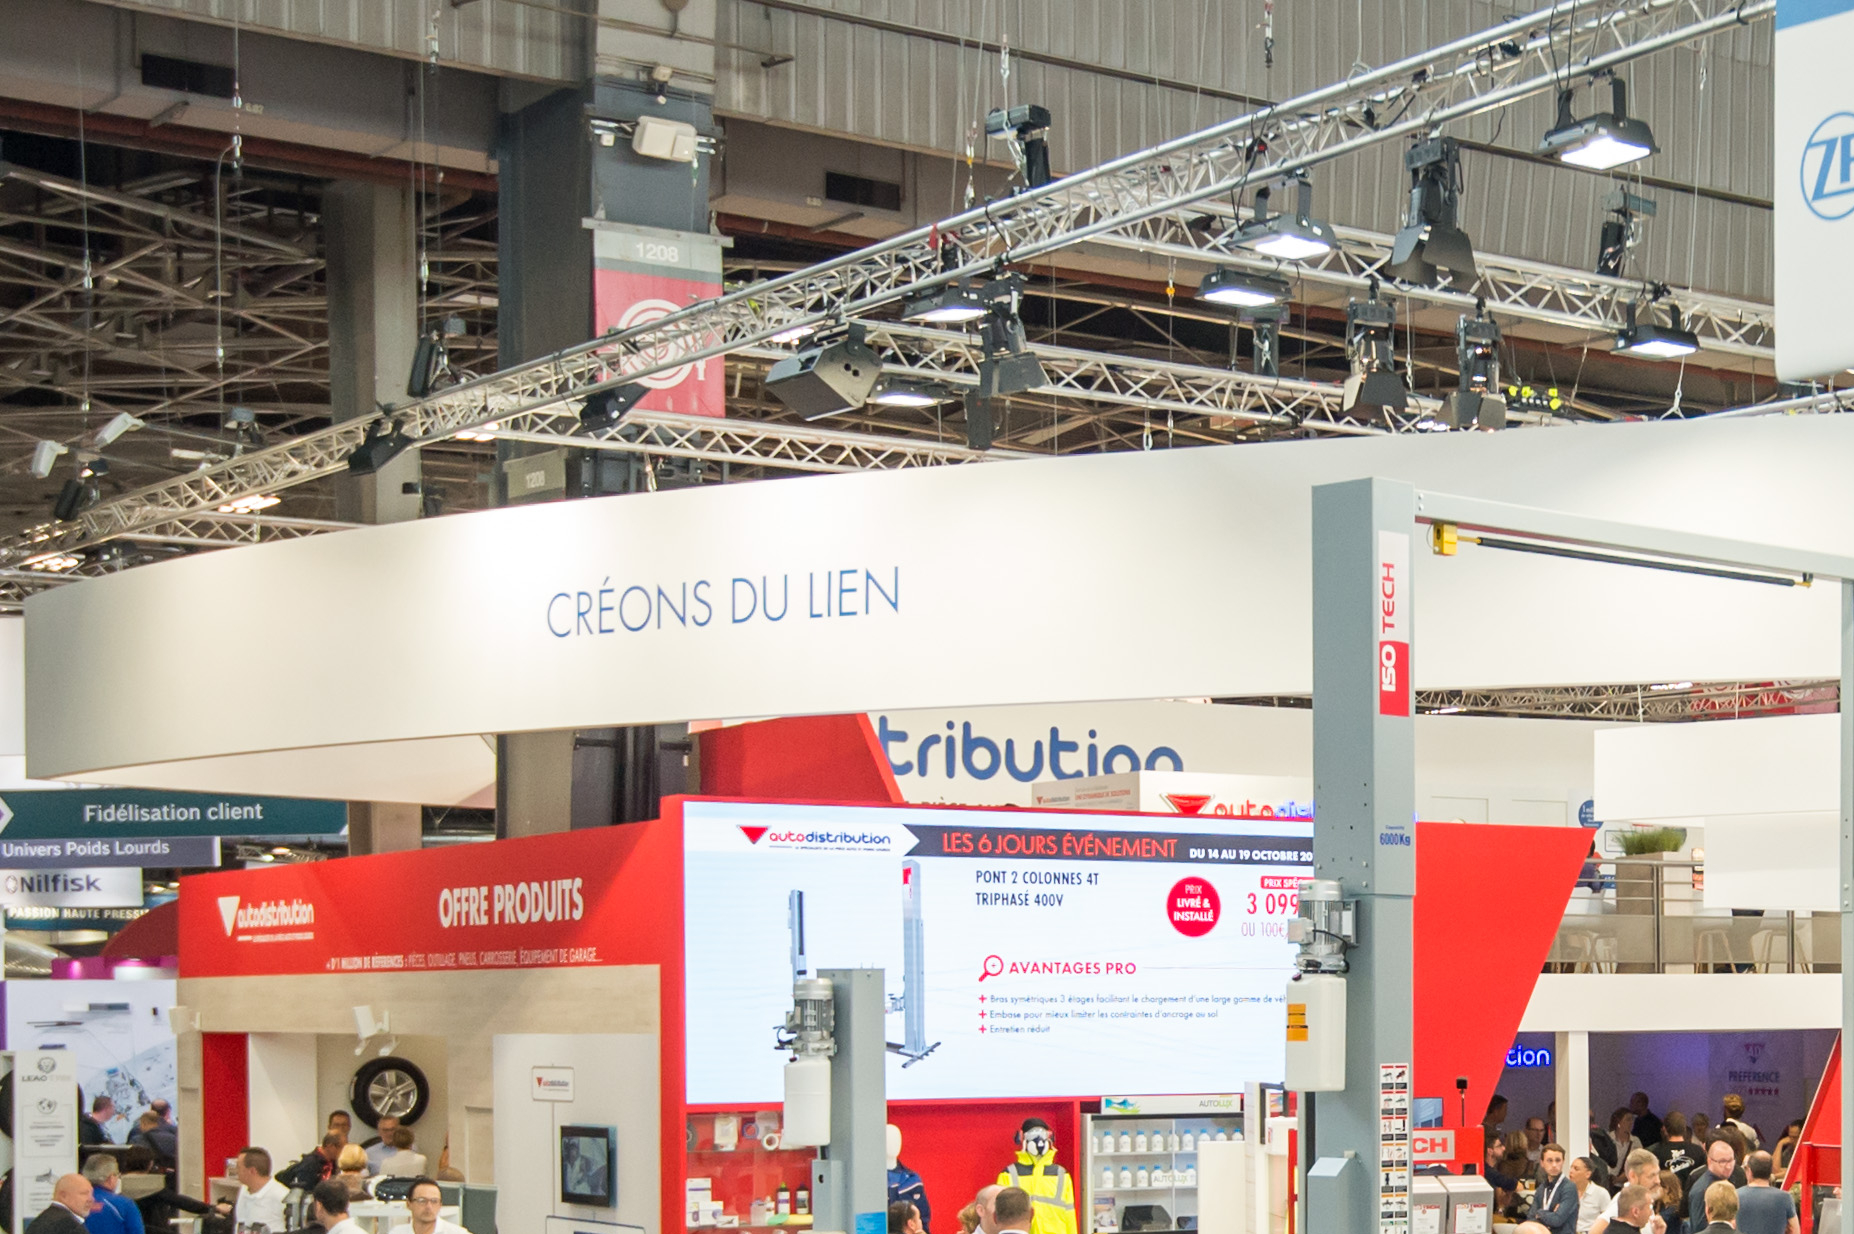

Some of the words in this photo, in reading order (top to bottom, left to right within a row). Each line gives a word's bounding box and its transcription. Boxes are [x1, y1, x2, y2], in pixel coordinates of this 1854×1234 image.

[635, 240, 680, 264] 1208
[547, 575, 713, 638] CRÉONS
[731, 573, 788, 624] DU
[809, 565, 900, 619] LIEN
[1382, 562, 1395, 634] TECH
[1381, 643, 1396, 692] ISO
[83, 802, 201, 823] Fidélisation
[206, 802, 264, 821] client
[769, 830, 891, 845] autodistribution
[942, 832, 974, 853] LES
[978, 833, 992, 854] 6
[995, 834, 1058, 856] JOURS
[1063, 832, 1178, 858] ÉVÉNEMENT
[1, 841, 62, 857] Univers
[65, 840, 110, 856] Poids
[115, 840, 170, 856] Lourds
[1189, 848, 1205, 859] DU
[1207, 849, 1220, 860] 14
[1221, 849, 1237, 860] AU
[1239, 849, 1251, 861] 19
[1251, 850, 1299, 862] OCTOBRE
[20, 873, 103, 893] Nilfisk
[975, 870, 1008, 884] PONT
[1011, 871, 1018, 884] 2
[1022, 871, 1083, 886] COLONNES
[1086, 872, 1100, 886] 4T
[1264, 878, 1282, 888] PRIX
[1184, 884, 1203, 895] PRIX
[438, 885, 490, 928] OFFRE
[493, 877, 585, 925] PRODUITS
[975, 890, 1030, 906] TRIPHASÉ
[1034, 893, 1064, 907] 400V
[1176, 897, 1201, 909] LIVRÉ
[1202, 898, 1211, 909] &
[1246, 892, 1258, 915] 3
[9, 906, 60, 920] PASSION
[63, 907, 101, 920] HAUTE
[237, 898, 315, 929] autodistribution
[1173, 910, 1214, 922] INSTALLÉ
[1241, 922, 1256, 937] OU
[1008, 961, 1101, 975] AVANTAGES
[1105, 962, 1137, 975] PRO
[990, 994, 1008, 1004] Bras
[1010, 994, 1058, 1005] symétriques
[1060, 994, 1066, 1003] 3
[1068, 995, 1095, 1005] étages
[1132, 994, 1139, 1003] le
[1141, 994, 1187, 1005] chargement
[1211, 994, 1231, 1005] large
[1263, 994, 1273, 1003] de
[990, 1010, 1021, 1019] Embase
[1024, 1011, 1043, 1021] pour
[1045, 1010, 1069, 1019] mieux
[1098, 1010, 1108, 1019] les
[1207, 1010, 1218, 1018] sol
[1198, 1099, 1233, 1108] AUTOLUX
[1152, 1174, 1188, 1184] AUTOLUX
